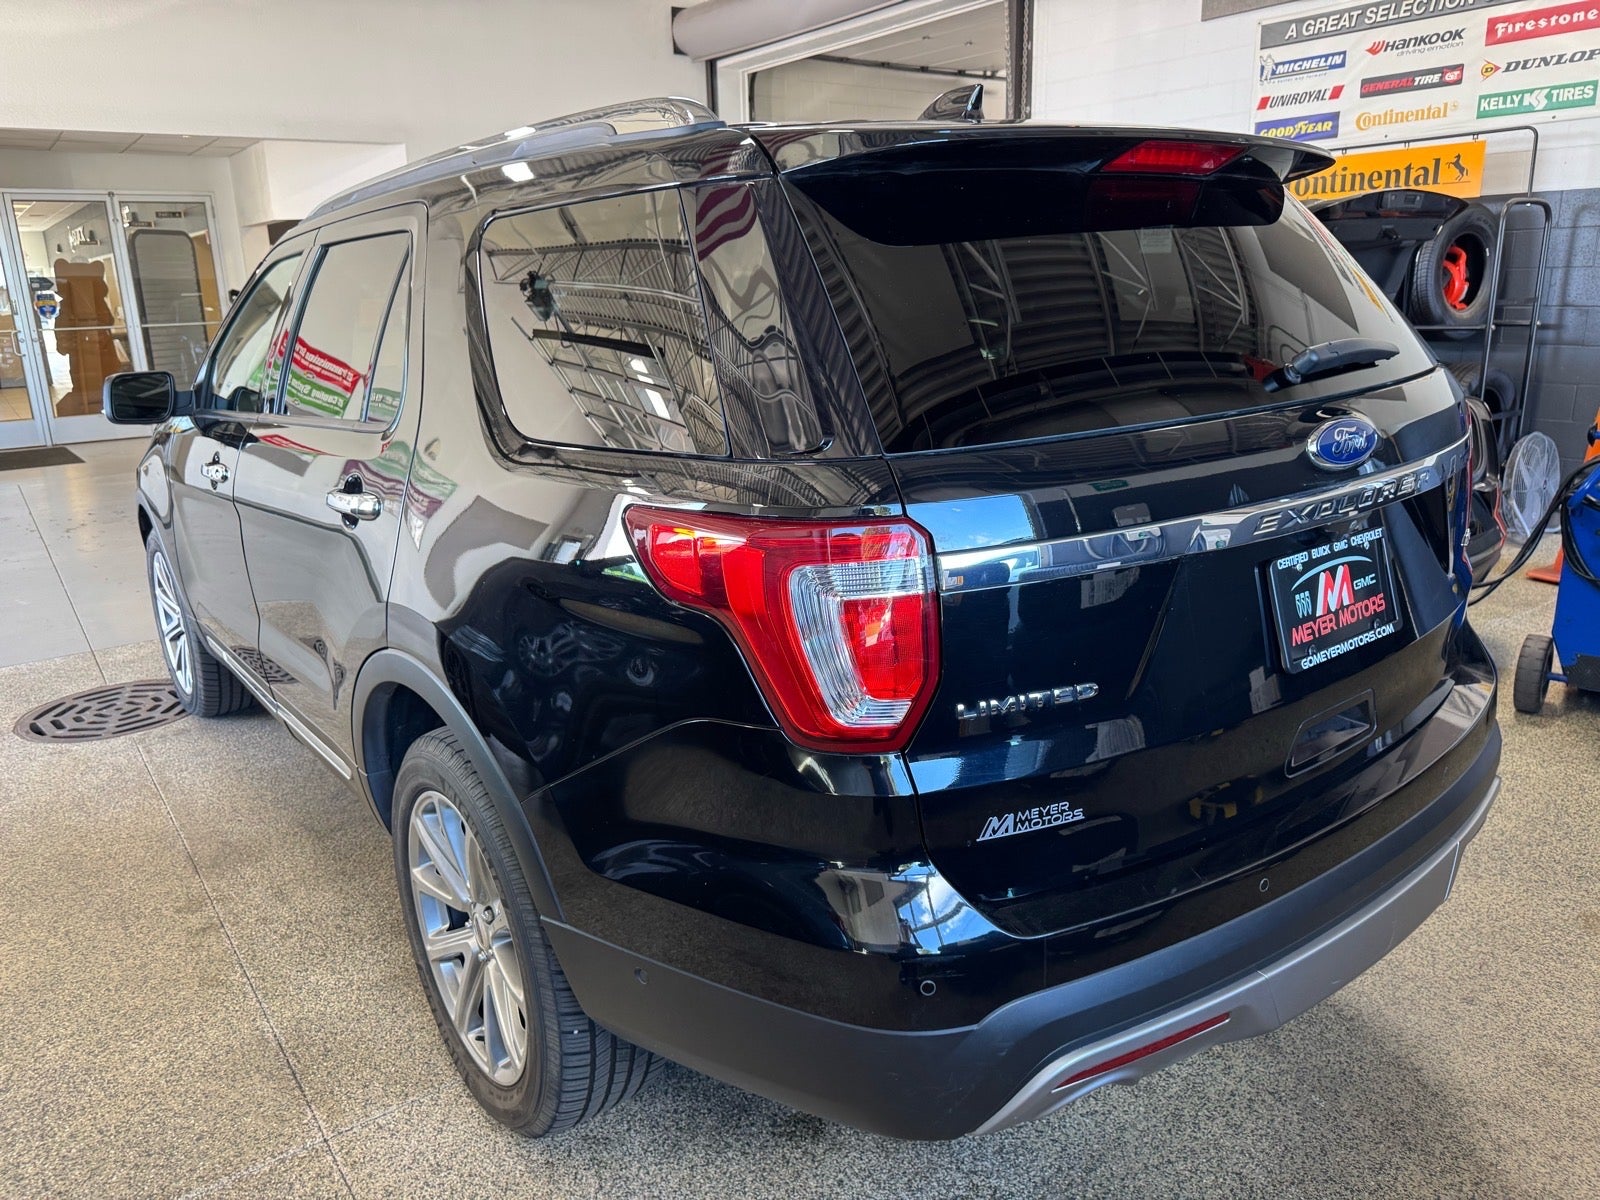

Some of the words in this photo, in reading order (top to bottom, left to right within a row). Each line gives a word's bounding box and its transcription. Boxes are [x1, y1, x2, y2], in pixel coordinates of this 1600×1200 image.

[1285, 23, 1297, 40] A
[1302, 10, 1362, 36] GREAT
[1494, 8, 1599, 39] Firestone
[1397, 47, 1426, 56] driving
[1427, 41, 1464, 52] emotion
[1501, 48, 1600, 73] DUNLOP
[1275, 54, 1344, 74] MICHELIN
[1361, 76, 1414, 93] GENERAL
[1414, 73, 1442, 85] TIRE
[1269, 88, 1330, 108] UNIROYAL
[1480, 94, 1522, 111] KELLY
[1551, 85, 1594, 102] TIRES
[1260, 121, 1332, 138] GOODYEAR
[1355, 102, 1449, 131] Continental
[1288, 157, 1441, 197] ontinental
[1332, 427, 1369, 458] Ford
[1253, 471, 1430, 535] EXPLORER
[1277, 551, 1309, 570] CERTIFIED
[1311, 544, 1331, 559] BUICK
[1333, 540, 1348, 552] GMC
[1350, 528, 1383, 546] CHEVROLET
[1353, 573, 1377, 591] GMC
[1291, 617, 1338, 647] MEYER
[1339, 593, 1386, 628] MOTORS
[1301, 623, 1395, 670] GOMEYERMOTORS.COM
[956, 683, 1099, 720] LIMITED
[1015, 808, 1084, 832] MOTORS
[1016, 801, 1070, 822] MEYER
